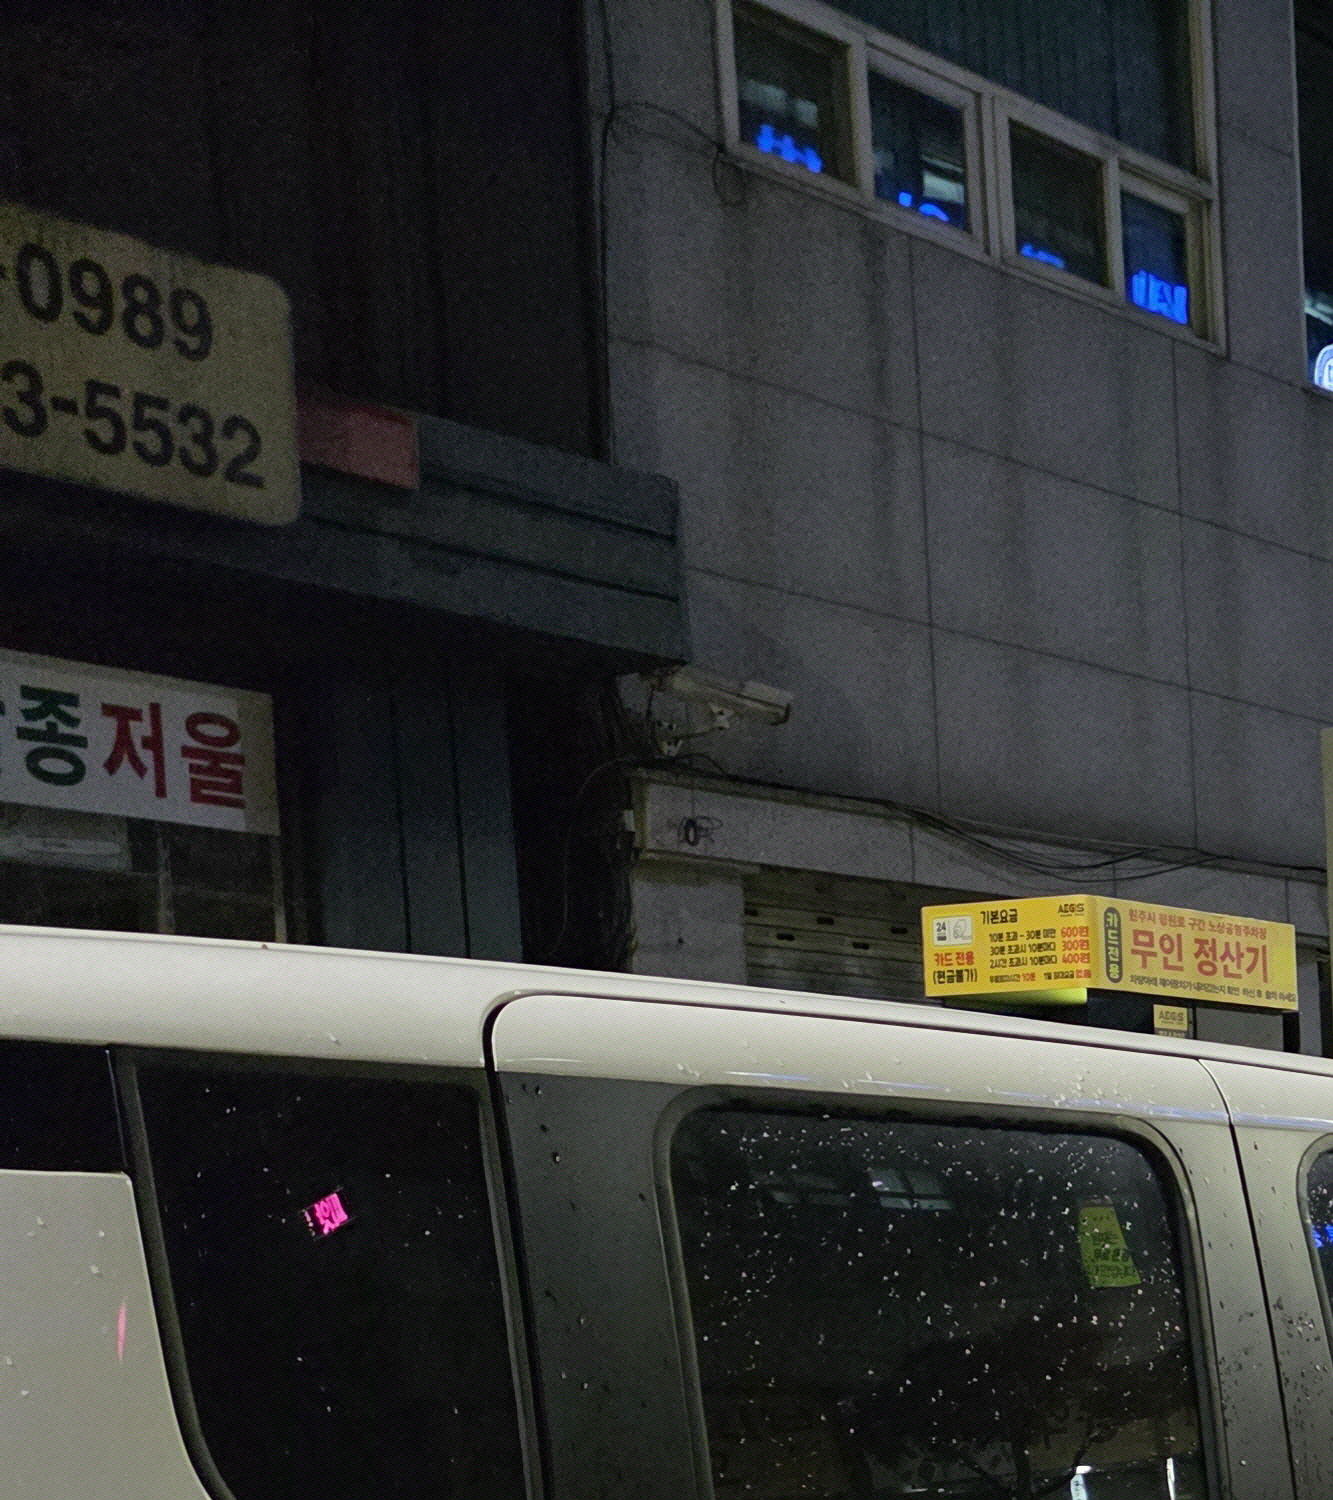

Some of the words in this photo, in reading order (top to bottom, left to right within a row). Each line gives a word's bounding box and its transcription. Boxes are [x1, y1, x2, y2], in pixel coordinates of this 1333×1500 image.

[0, 243, 213, 362] 0989
[0, 684, 89, 788] 종
[980, 909, 1018, 925] 기본요금
[1128, 908, 1156, 925] 원주시
[936, 922, 947, 932] 24
[1060, 926, 1089, 938] 600원
[1062, 939, 1090, 951] 300원
[934, 952, 954, 967] 카드
[955, 950, 974, 965] 전용
[1062, 952, 1091, 964] 400원
[1130, 928, 1185, 972] 무인
[1193, 937, 1268, 984] 정산기
[932, 968, 978, 985] (현금불가)
